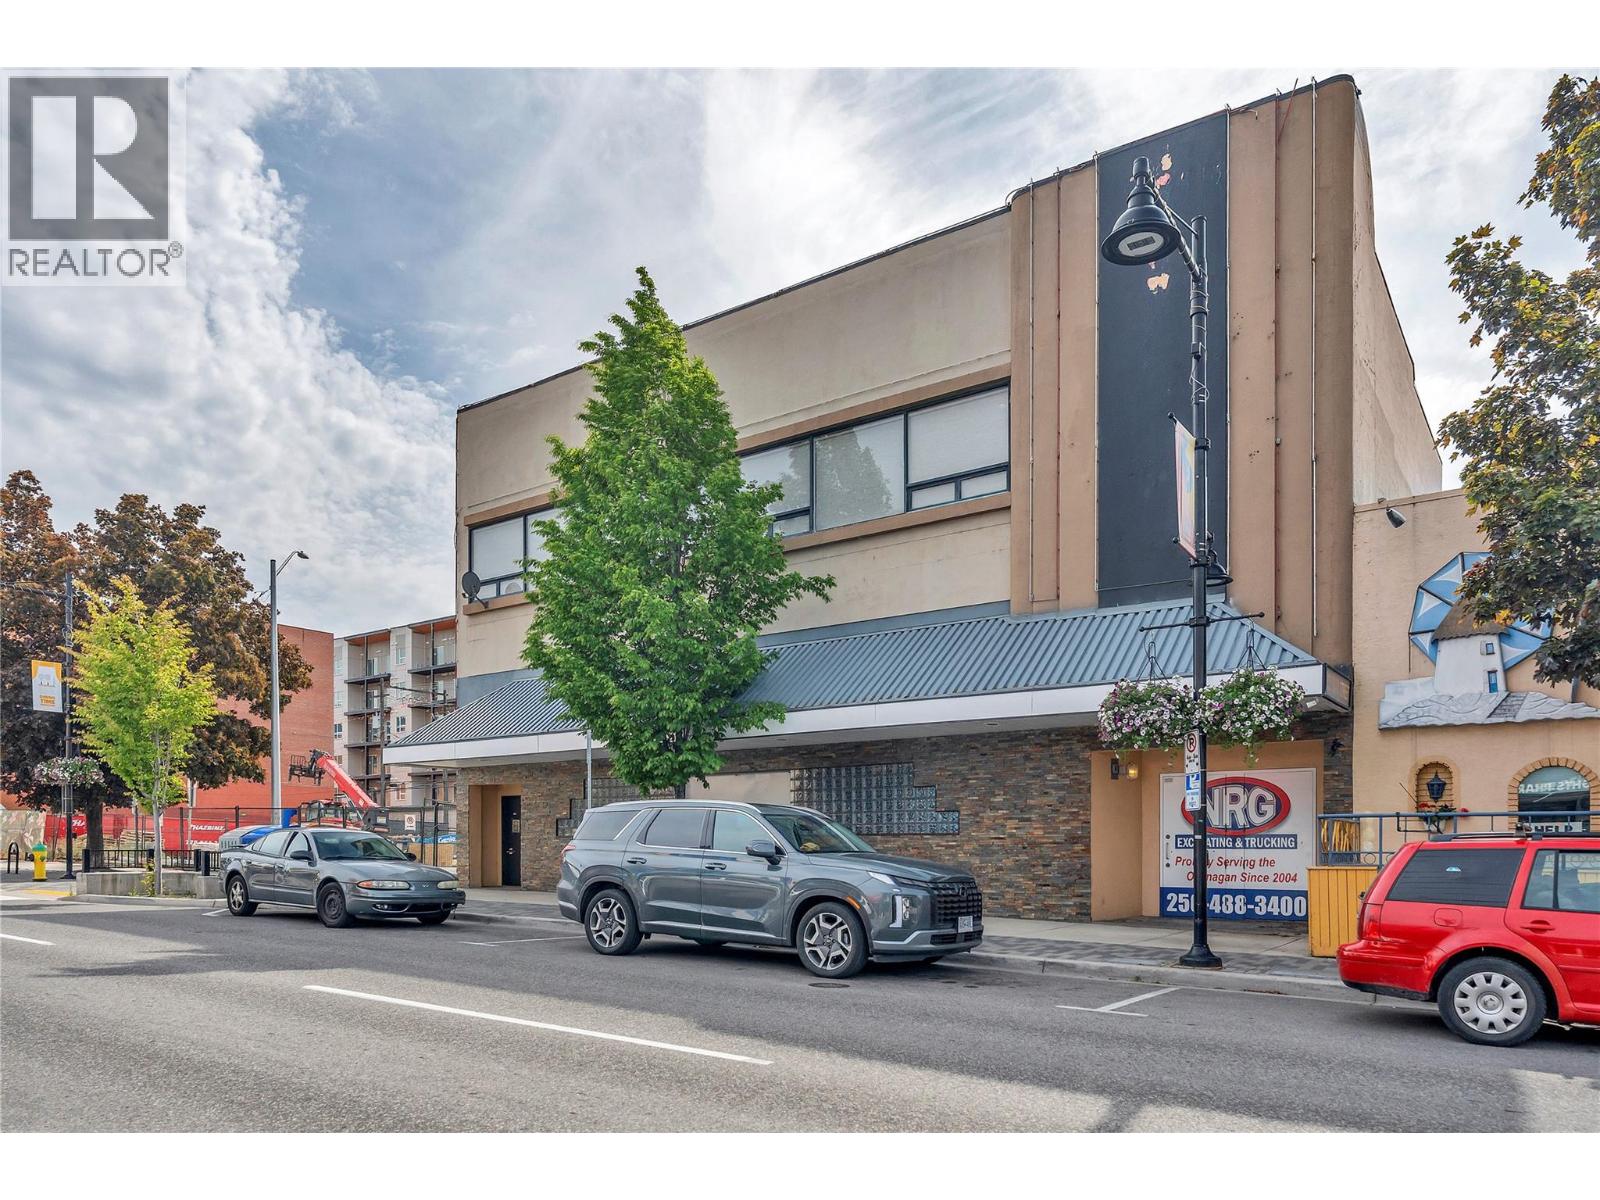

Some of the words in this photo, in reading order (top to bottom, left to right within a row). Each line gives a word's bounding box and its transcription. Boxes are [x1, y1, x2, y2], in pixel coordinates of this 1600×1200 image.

[1177, 837, 1233, 848] EXCATING
[1235, 837, 1243, 848] &
[1245, 837, 1295, 848] TRUCKING
[1175, 856, 1214, 868] Proly
[1216, 856, 1256, 869] Serving
[1259, 857, 1276, 867] the
[1187, 871, 1237, 884] Onagan
[1240, 872, 1270, 883] Since
[1273, 872, 1298, 883] 2004
